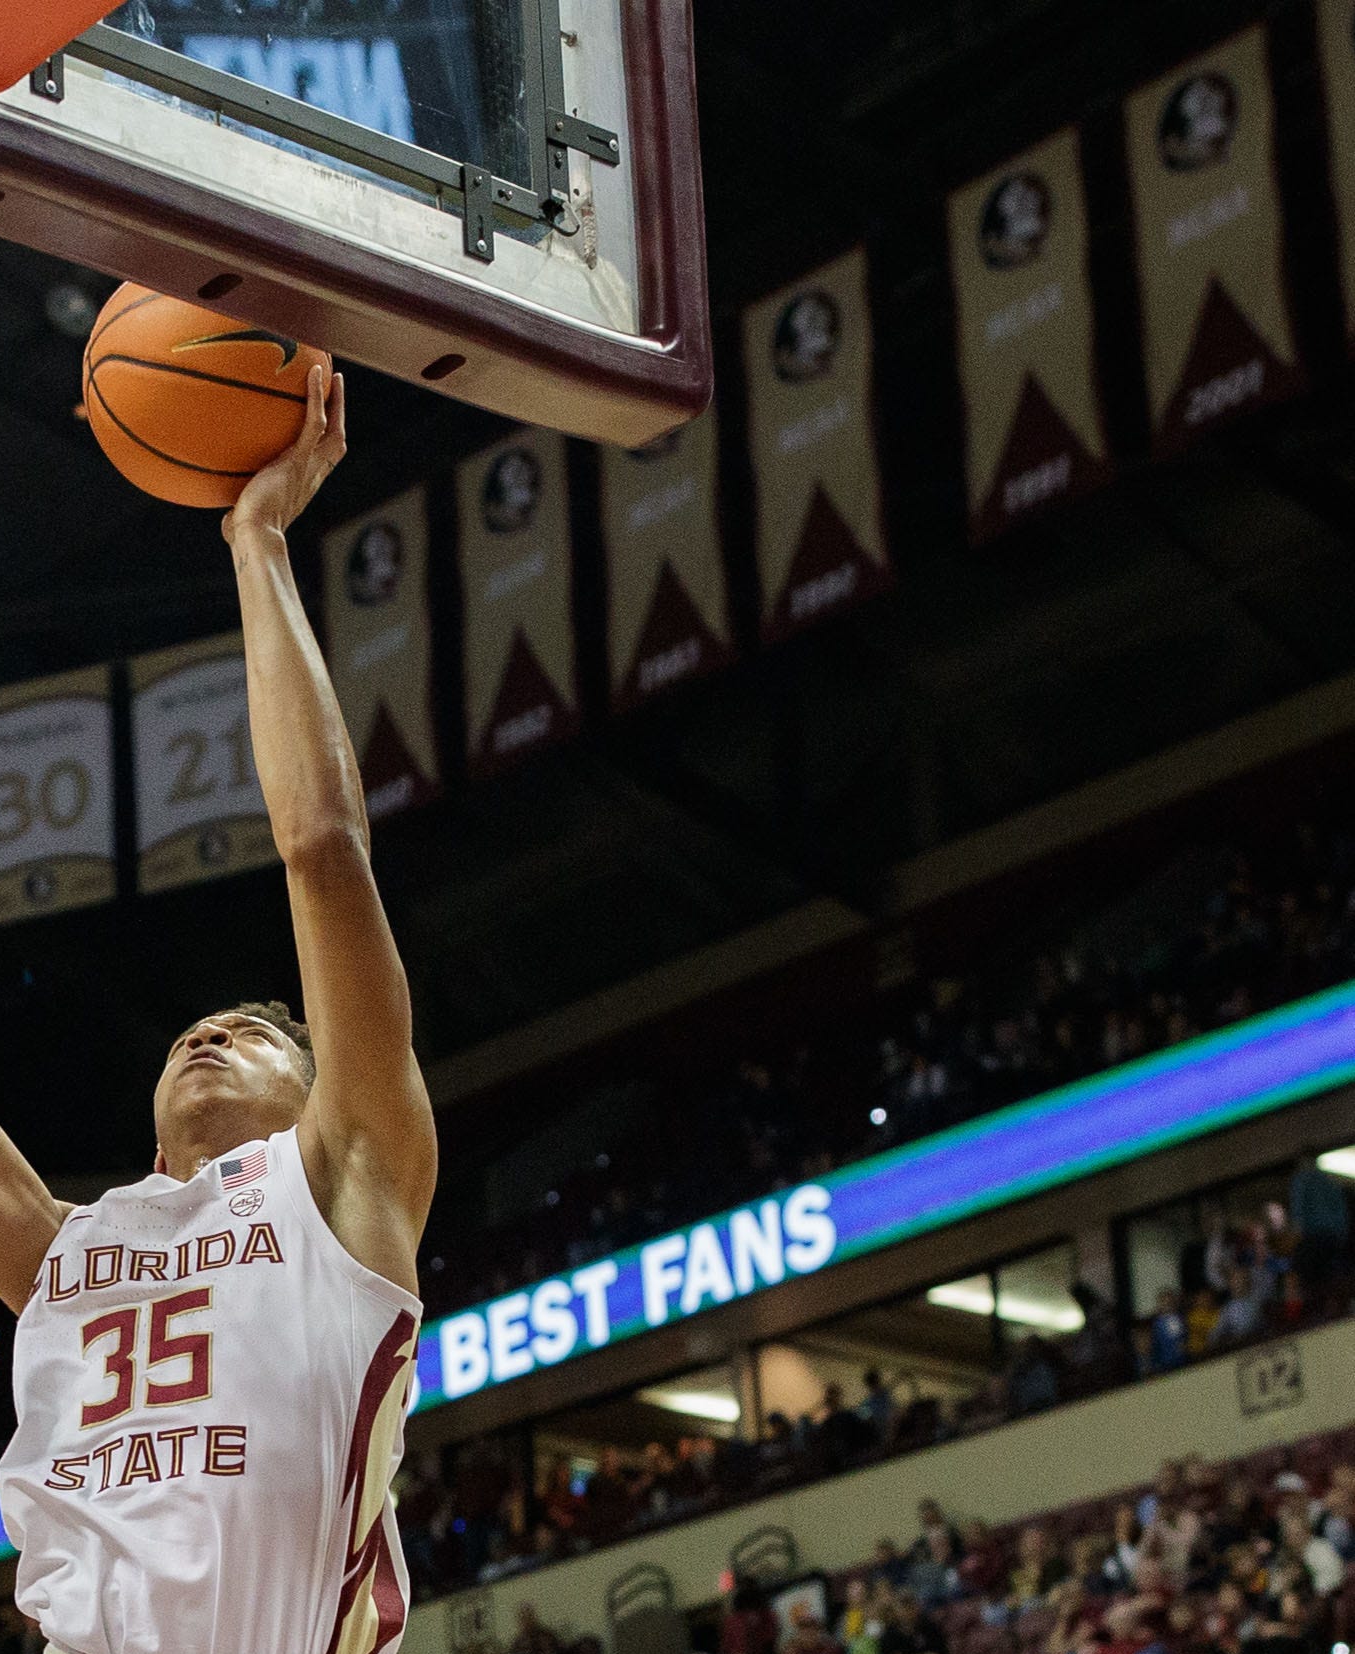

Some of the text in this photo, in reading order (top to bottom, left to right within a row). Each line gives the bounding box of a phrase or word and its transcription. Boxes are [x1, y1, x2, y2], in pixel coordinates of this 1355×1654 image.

[30, 1222, 285, 1304] LORIDA
[439, 1183, 838, 1400] BEST FANS
[79, 1286, 214, 1432] 35
[44, 1424, 248, 1496] STATE
